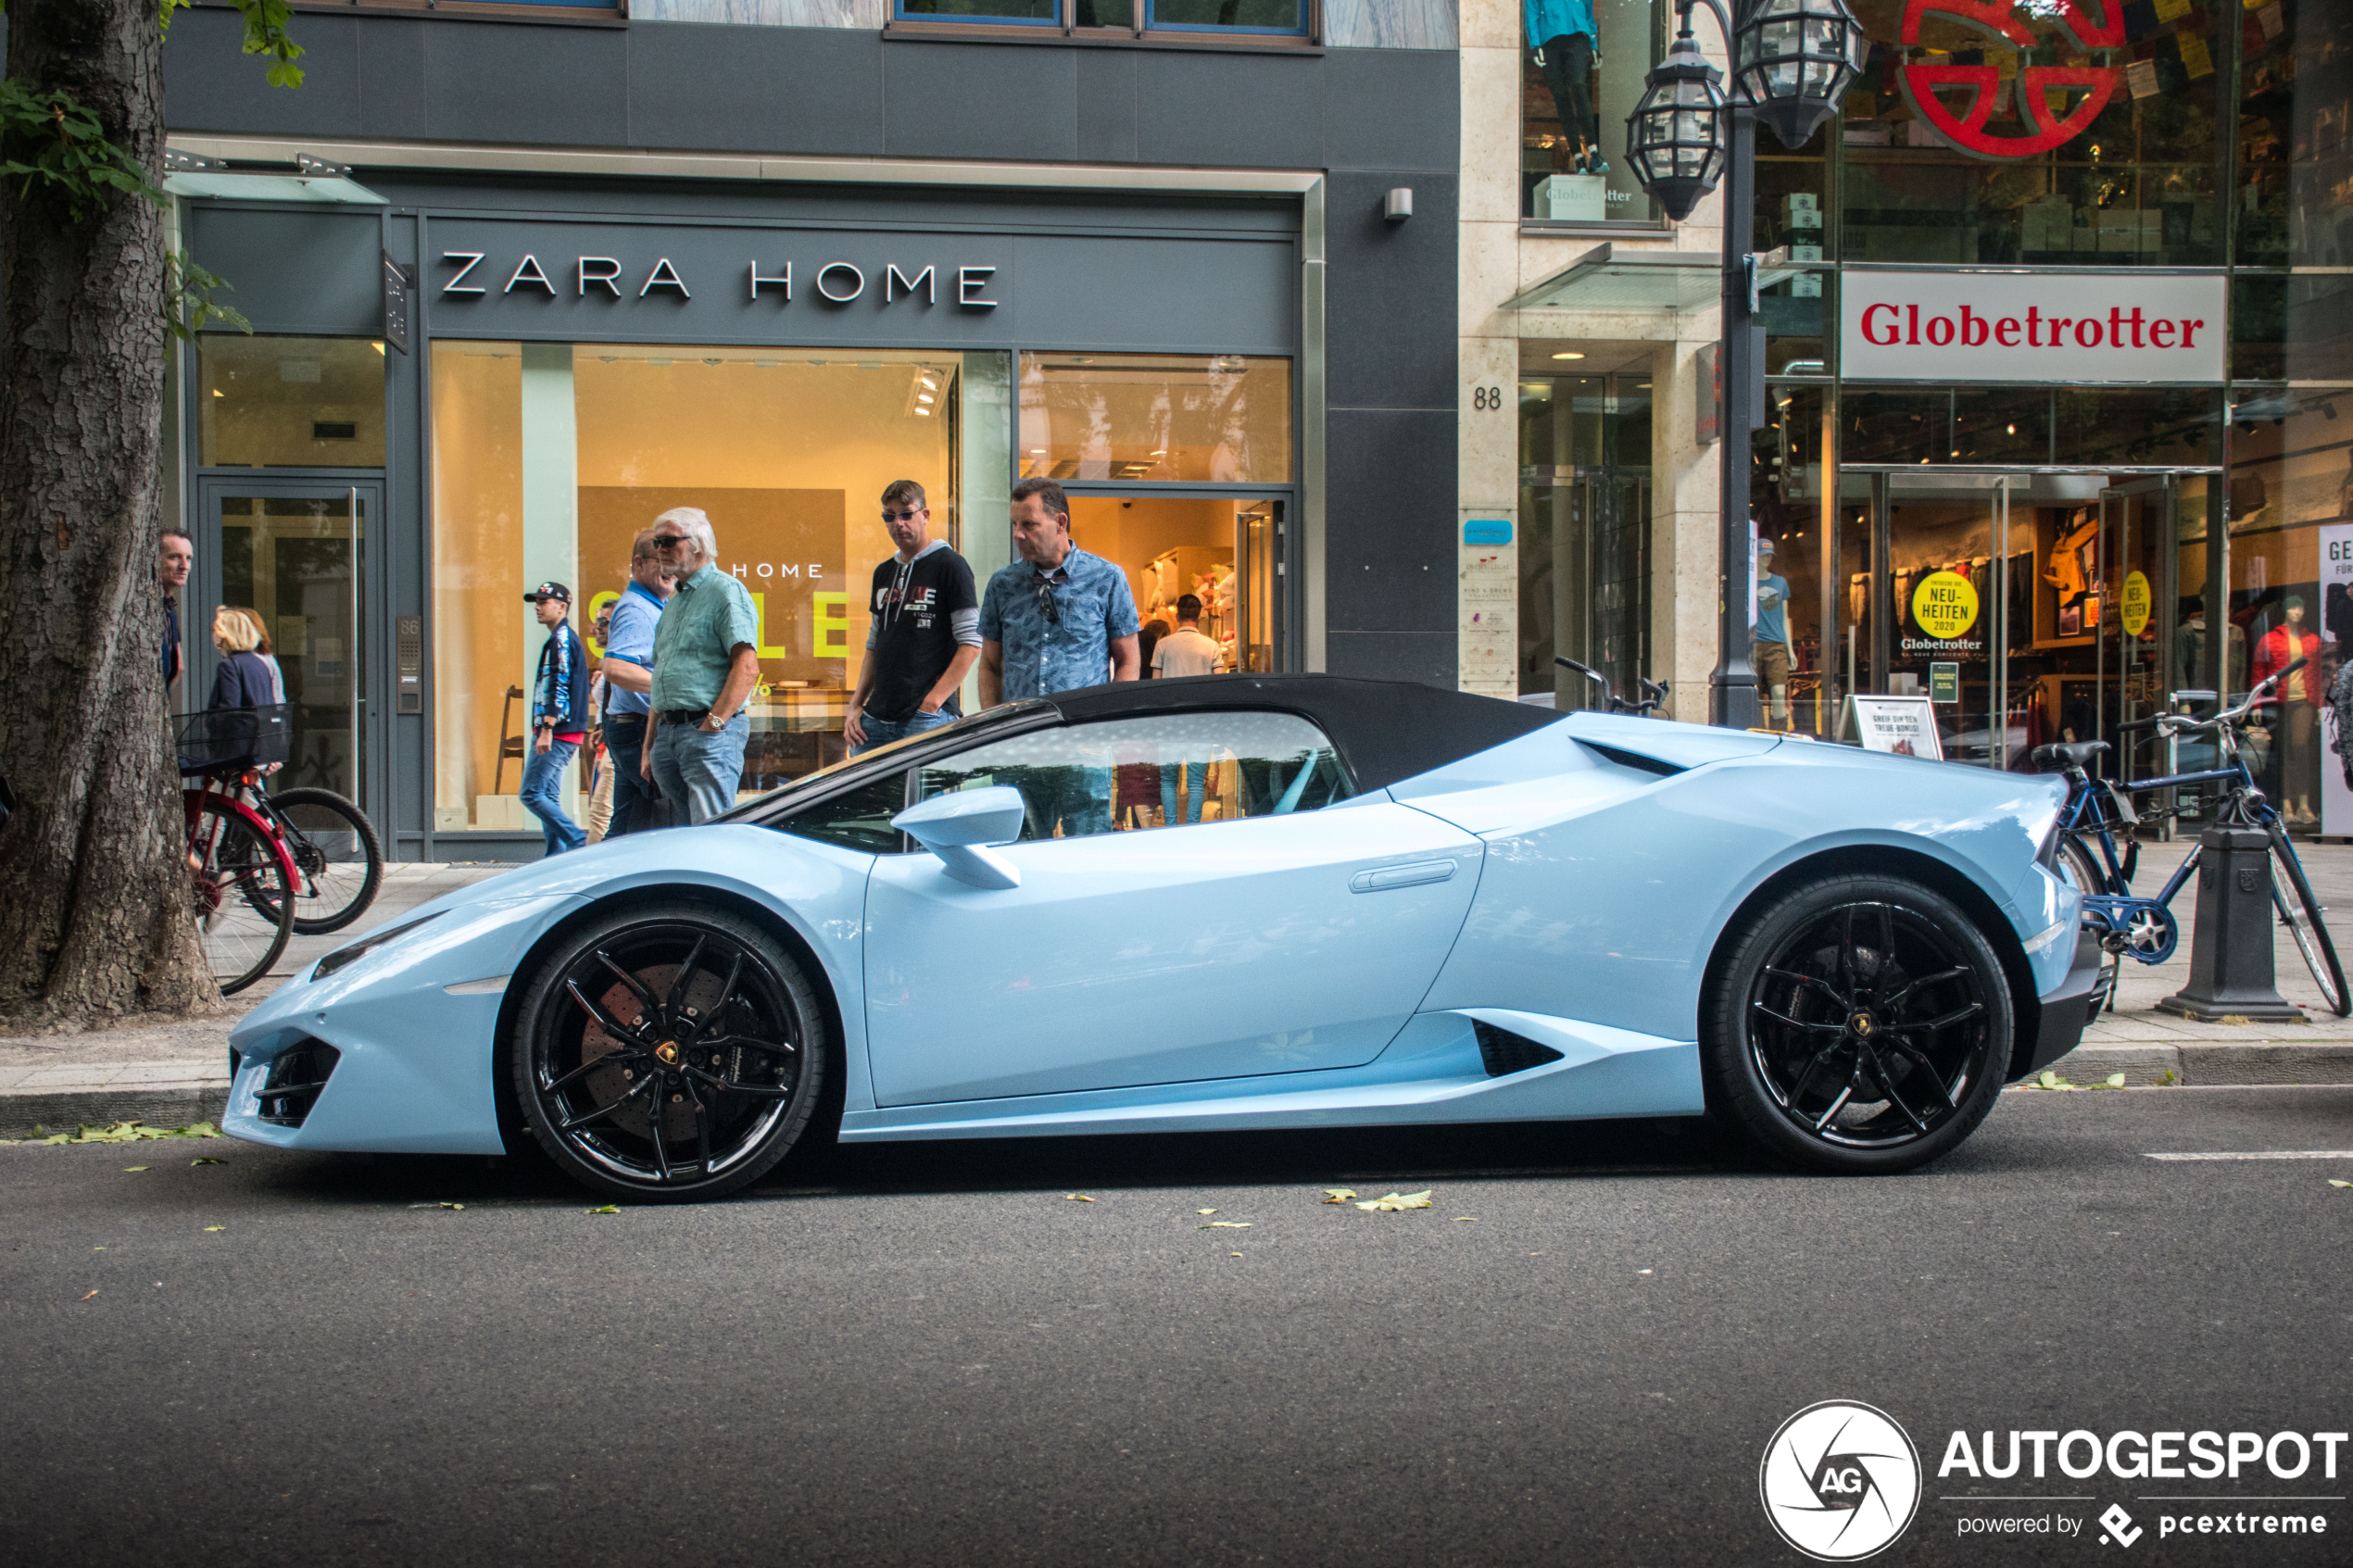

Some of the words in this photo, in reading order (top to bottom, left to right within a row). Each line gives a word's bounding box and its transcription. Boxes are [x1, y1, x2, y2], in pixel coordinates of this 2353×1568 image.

[443, 252, 691, 298] ZARA
[751, 259, 998, 307] HOME
[1860, 303, 2205, 348] Globetrotter
[1475, 386, 1501, 409] 88
[732, 563, 823, 578] HOME
[1930, 587, 1962, 603] NEU-
[1922, 604, 1969, 620] HEITEN
[401, 621, 419, 634] 86
[586, 591, 849, 659] SLE
[1934, 621, 1956, 631] 2020
[1900, 638, 1982, 649] Globetrotter
[1873, 715, 1892, 723] GREIF
